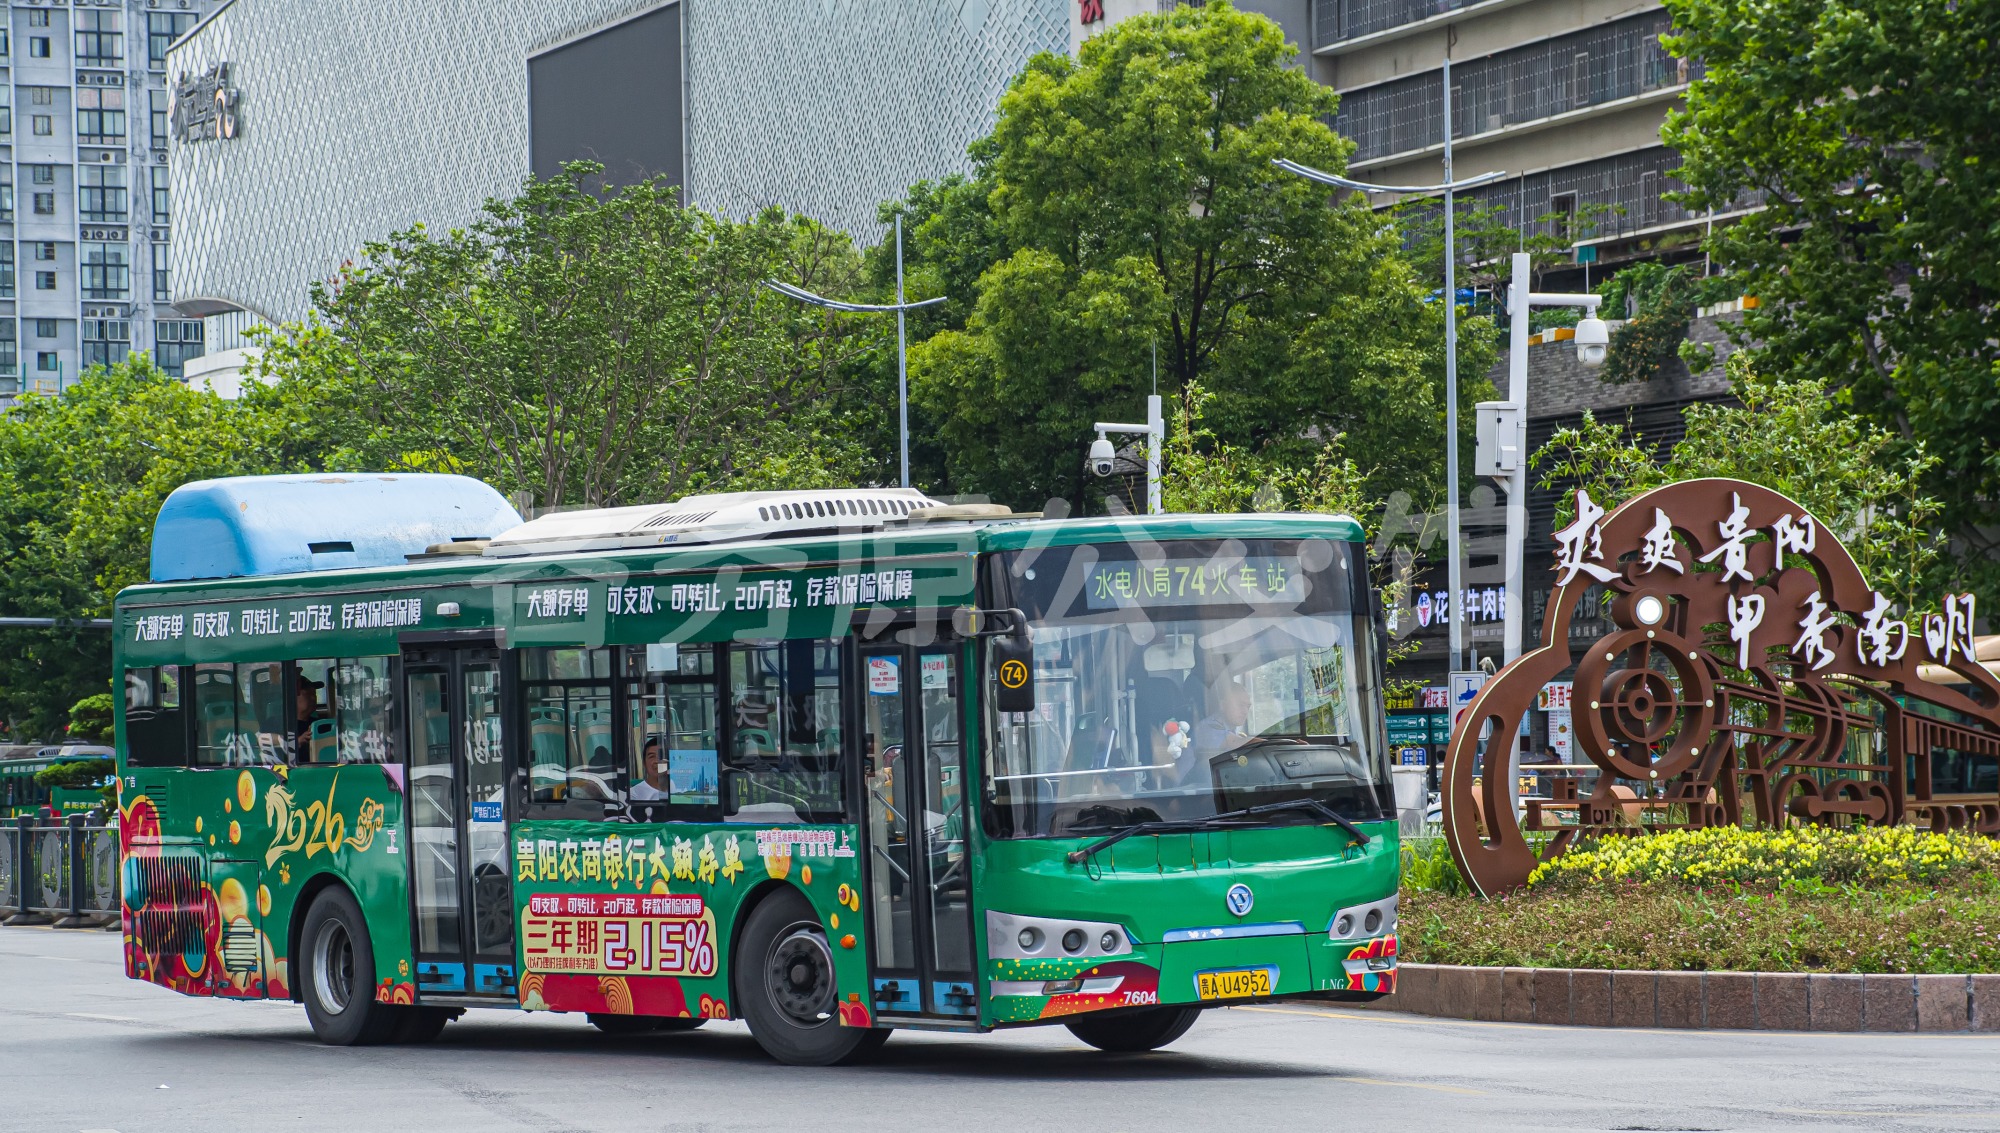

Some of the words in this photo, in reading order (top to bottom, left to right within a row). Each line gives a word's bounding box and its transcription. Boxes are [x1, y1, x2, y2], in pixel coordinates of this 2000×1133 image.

[1553, 489, 1816, 587] 爽爽贵阳
[1094, 567, 1171, 600] 水电八局
[1174, 566, 1206, 597] 74
[1211, 562, 1287, 595] 火车站
[527, 585, 589, 618] 大额存单
[135, 615, 184, 642] 大额存单
[1726, 591, 1976, 670] 甲秀南明
[1004, 666, 1023, 682] 74
[124, 776, 136, 788] 广告
[265, 772, 344, 870] 2026
[474, 806, 501, 819] 严禁后门上车
[526, 919, 598, 955] 三年期
[603, 918, 712, 975] 2.15%
[1123, 990, 1157, 1005] 7604
[1322, 977, 1345, 990] LNG
